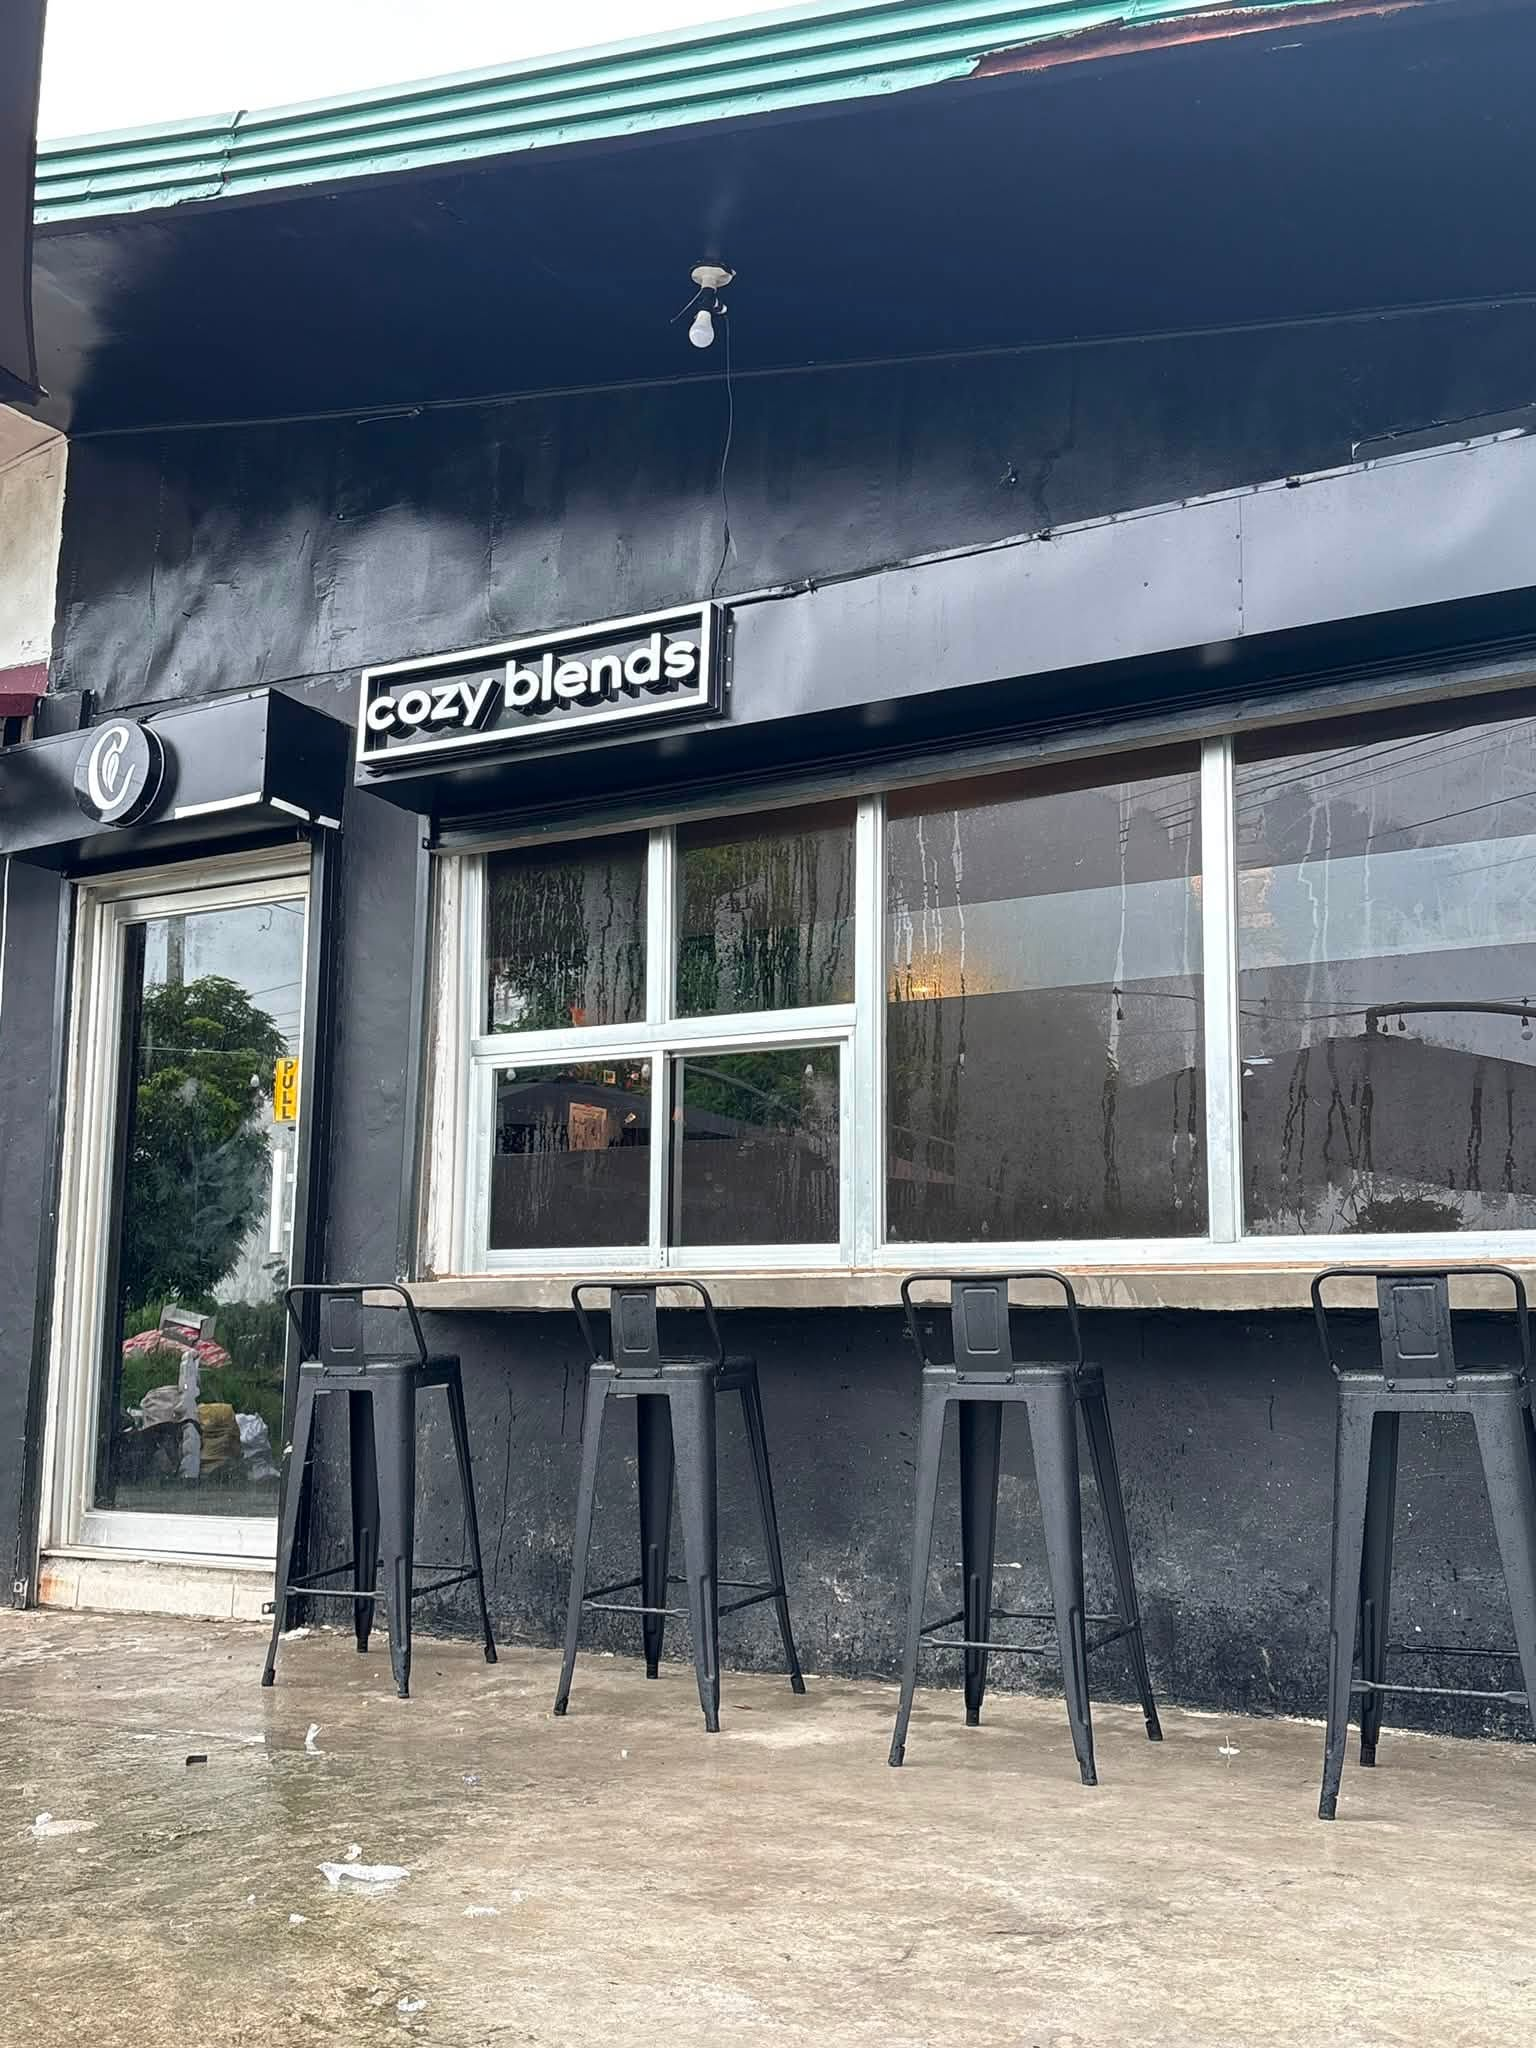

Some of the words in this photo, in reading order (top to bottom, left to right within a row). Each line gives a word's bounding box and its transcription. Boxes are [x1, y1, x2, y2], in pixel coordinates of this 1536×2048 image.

[366, 677, 495, 731] cozy
[504, 632, 697, 708] blends
[281, 1060, 295, 1120] PULL
